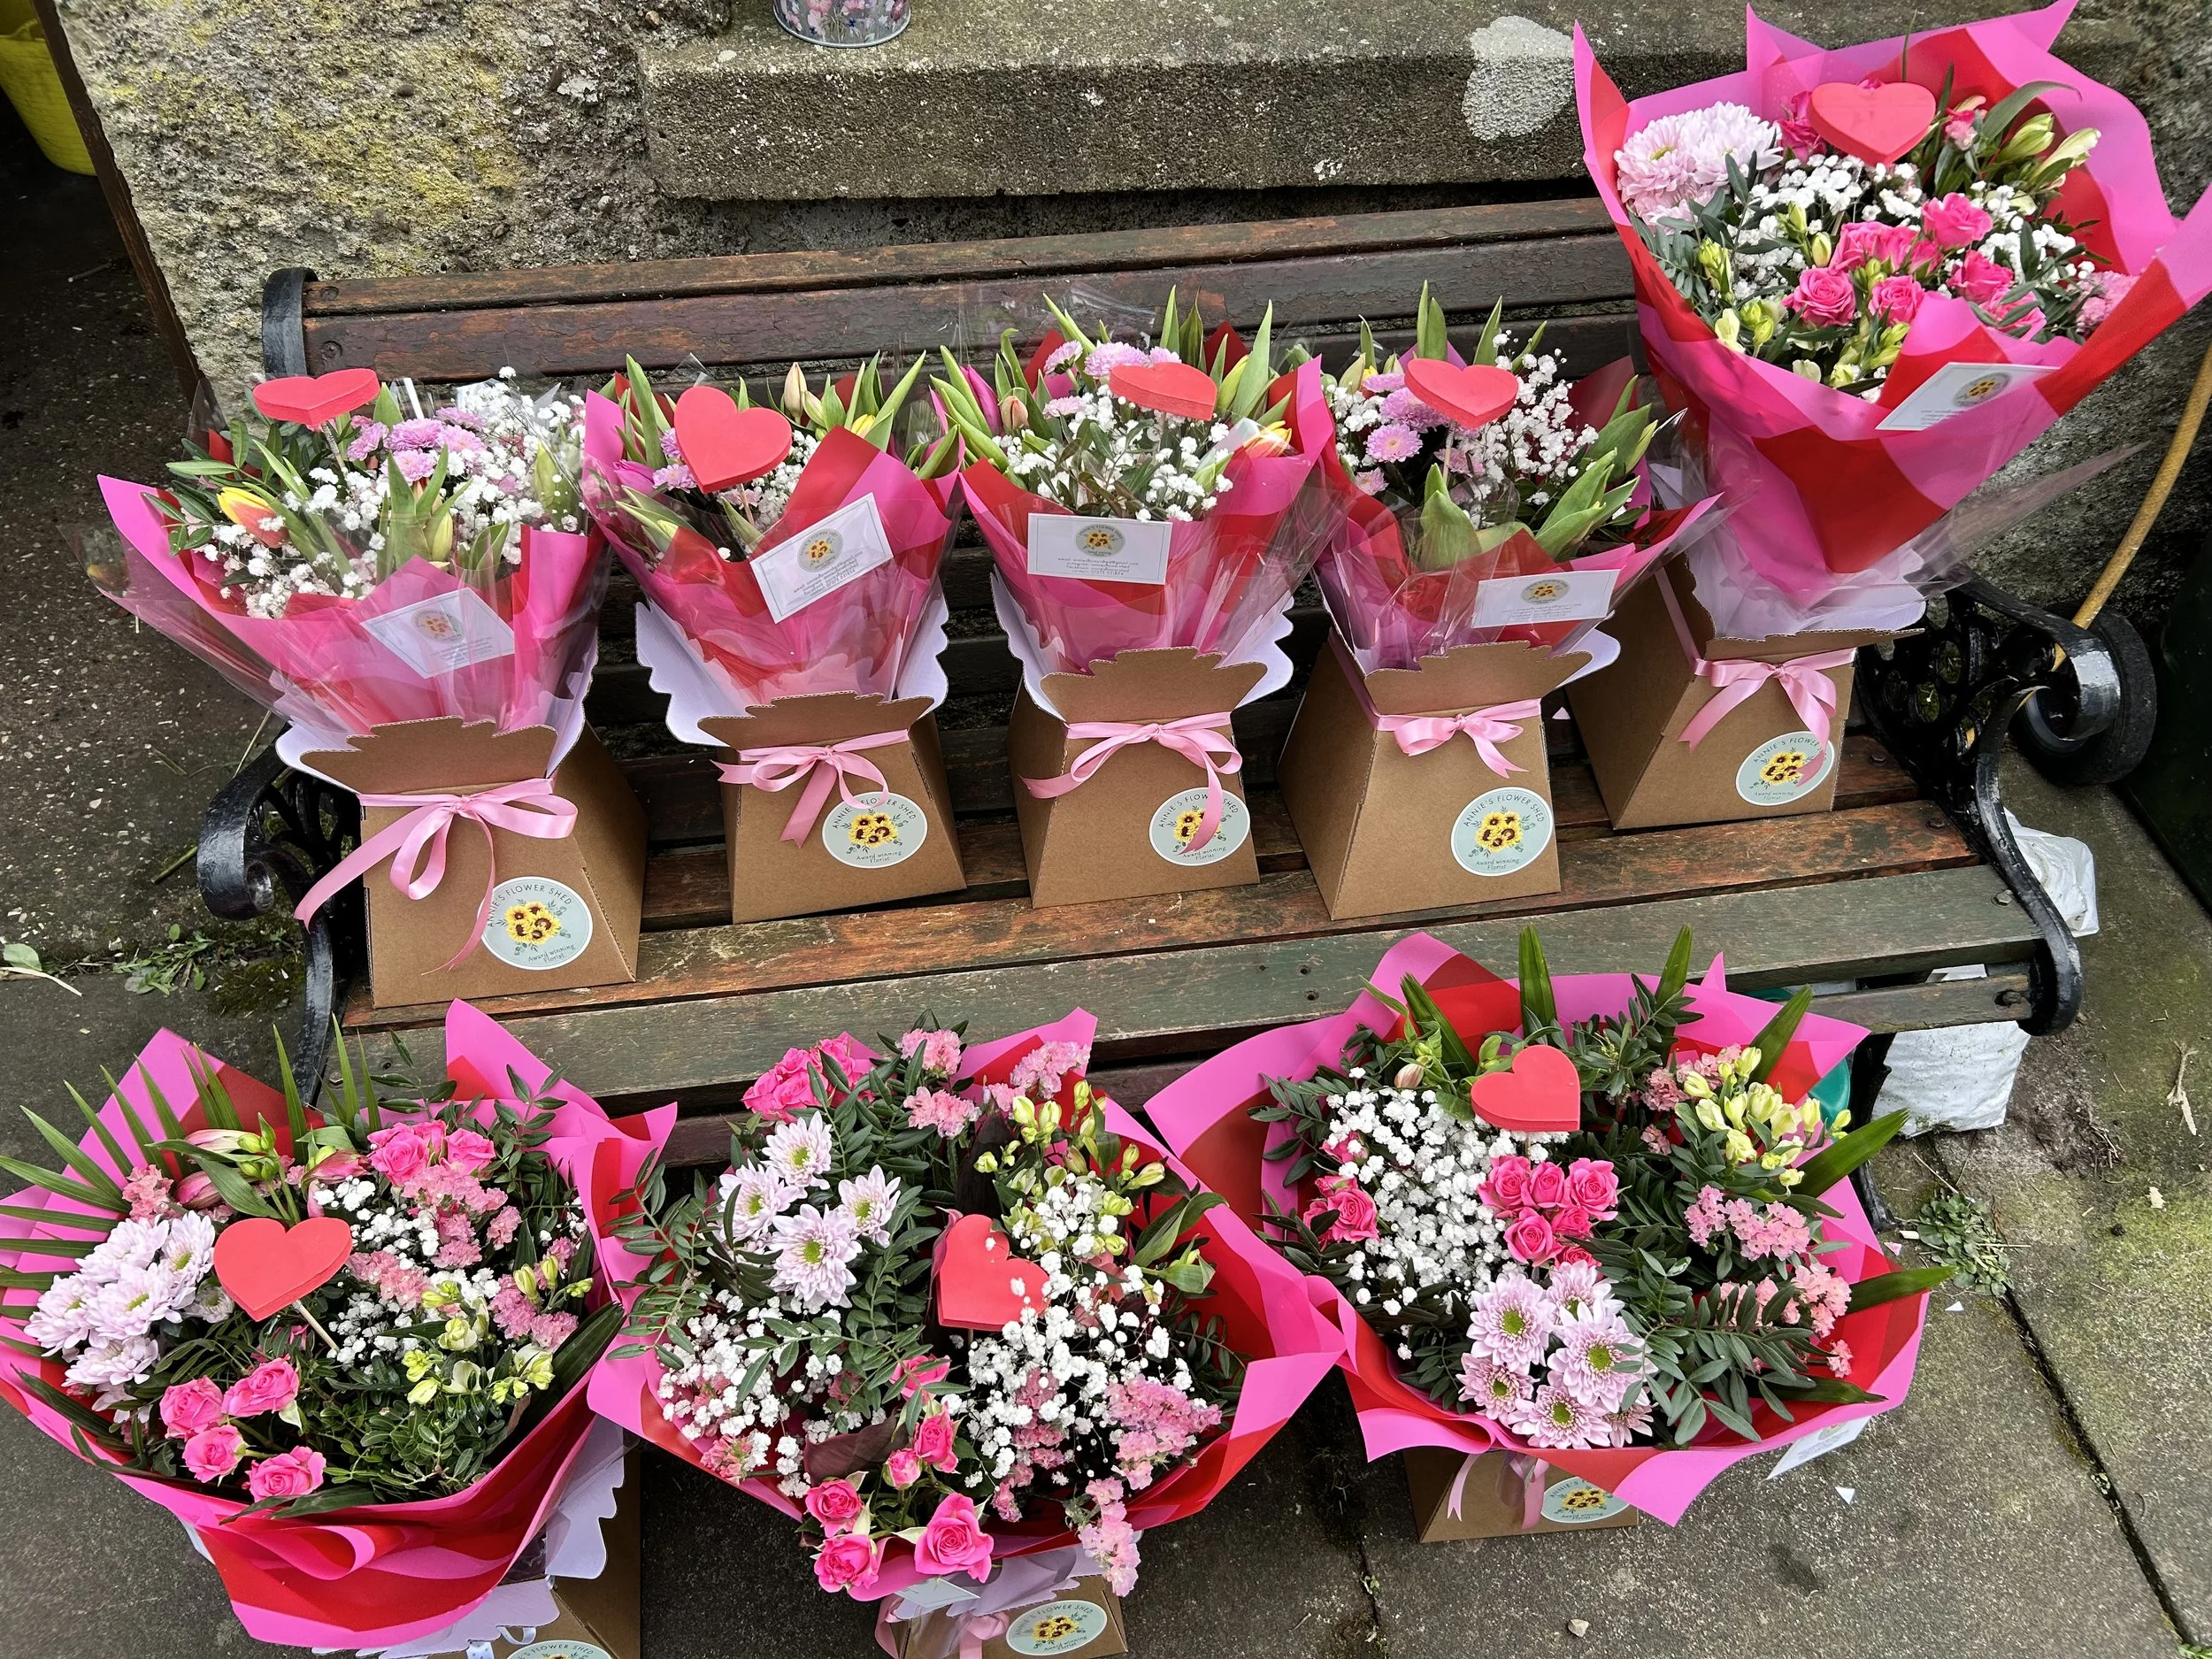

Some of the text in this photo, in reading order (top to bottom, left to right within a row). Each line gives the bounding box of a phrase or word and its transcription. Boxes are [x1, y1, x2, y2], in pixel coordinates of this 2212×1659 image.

[1754, 741, 1786, 763] ANNIE'S
[860, 798, 897, 807] FLOER
[899, 804, 916, 819] SHED
[1158, 794, 1239, 828] ANNIE'S FLOW SHED
[1463, 795, 1544, 827] ANNIE'S FLOWER SHED
[1202, 846, 1226, 855] winning
[506, 884, 545, 896] FLOWER
[549, 888, 572, 905] SHED
[528, 944, 576, 962] Award winning
[543, 953, 565, 964] Florist
[1037, 1604, 1073, 1615] FLOWER
[1074, 1605, 1094, 1614] SHED
[531, 1644, 594, 1655] FLOWER SHED
[1064, 1636, 1087, 1645] winning
